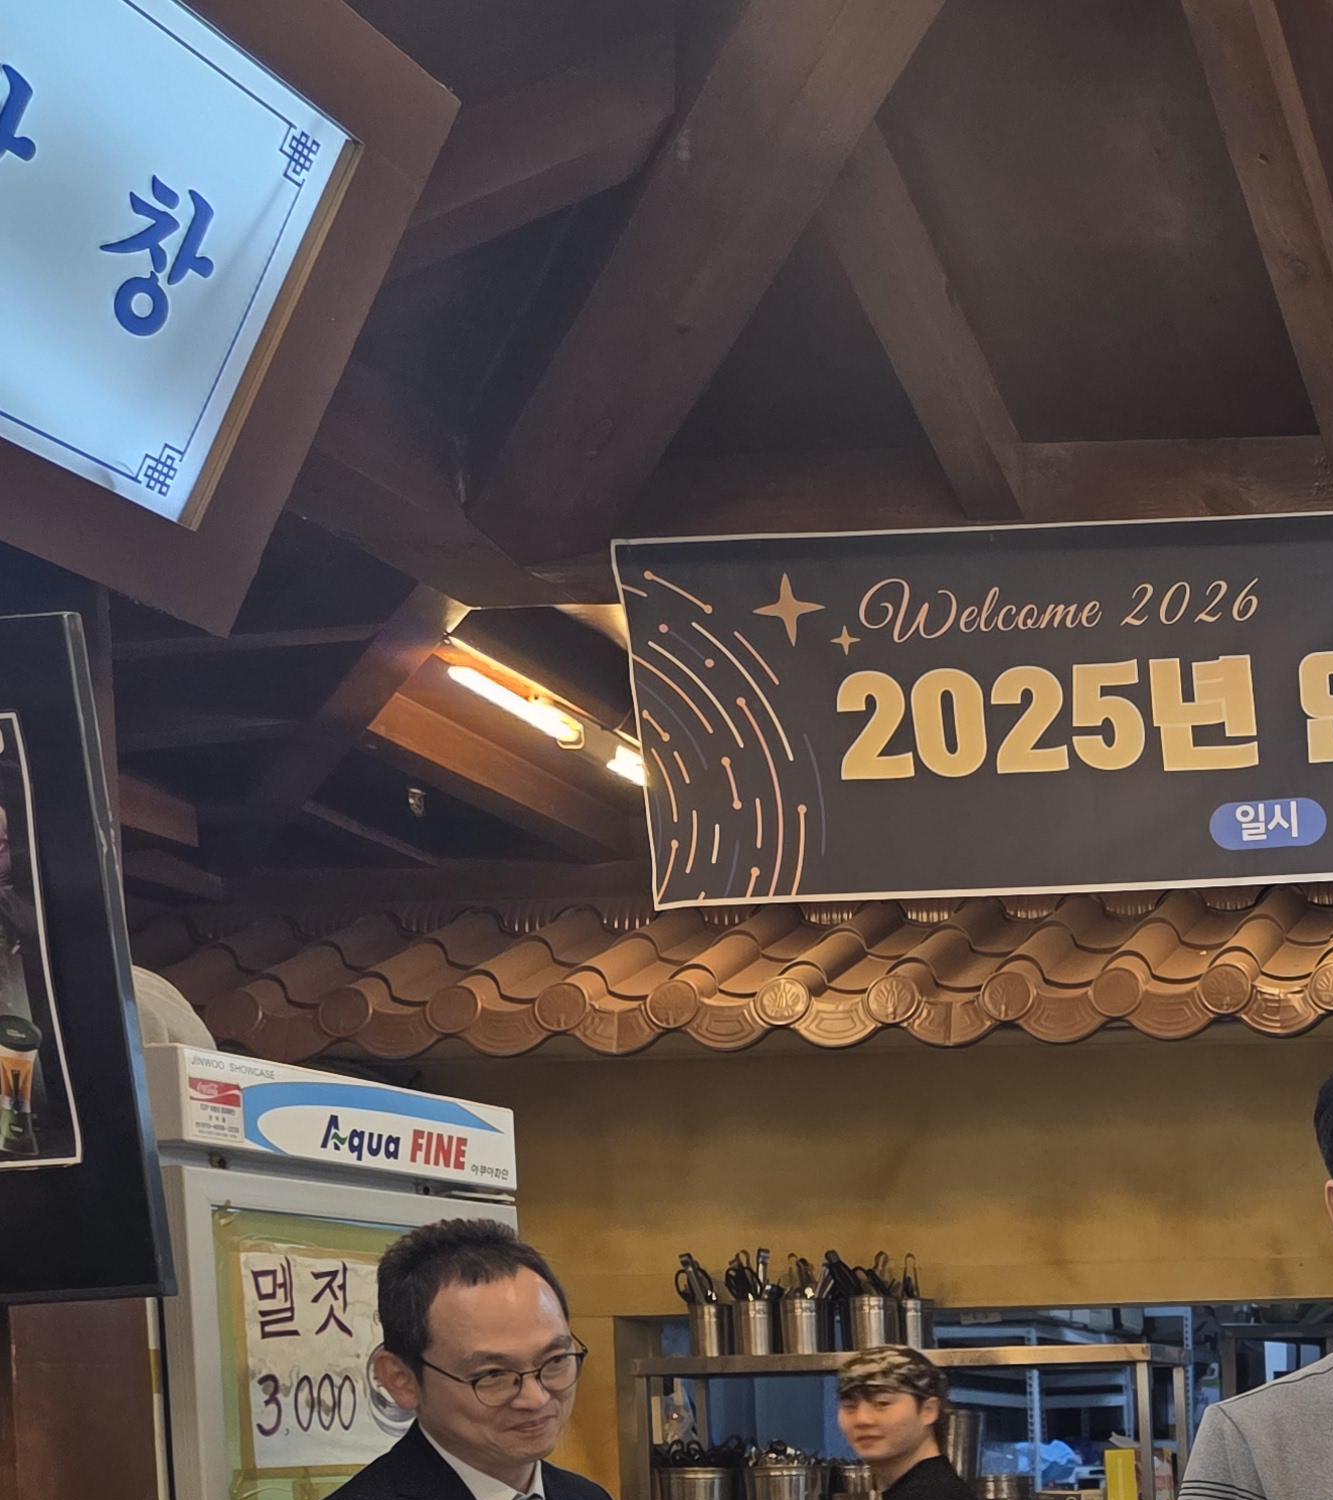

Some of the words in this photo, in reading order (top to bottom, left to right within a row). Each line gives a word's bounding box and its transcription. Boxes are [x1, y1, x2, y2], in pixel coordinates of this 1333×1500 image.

[857, 578, 1102, 643] Welcome
[1120, 577, 1261, 628] 2026
[835, 653, 1260, 781] 2025년
[1234, 800, 1299, 842] 일시
[320, 1114, 401, 1162] Aqua
[410, 1129, 468, 1170] FINE
[251, 1255, 354, 1340] 멜젓
